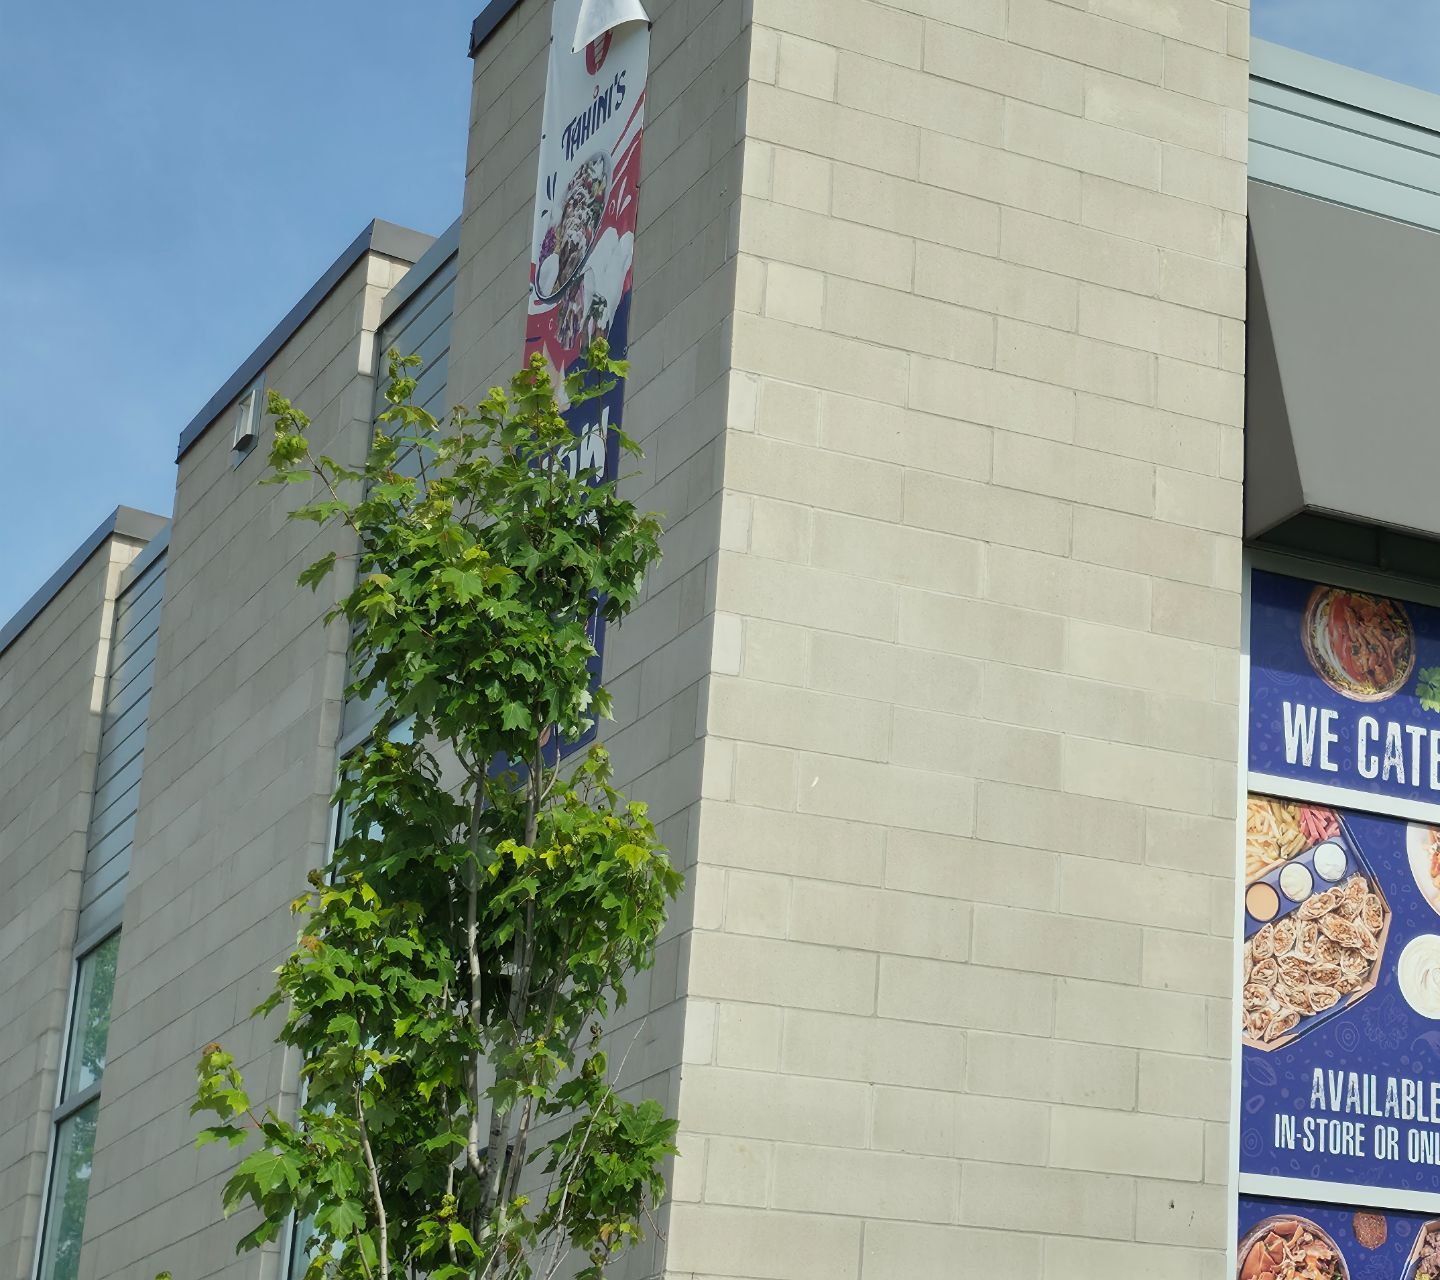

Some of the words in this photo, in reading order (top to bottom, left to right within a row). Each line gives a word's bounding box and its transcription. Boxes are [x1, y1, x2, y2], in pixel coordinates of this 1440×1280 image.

[1282, 701, 1340, 773] WE
[1274, 1113, 1366, 1159] IN-STORE
[1374, 1124, 1399, 1162] OR
